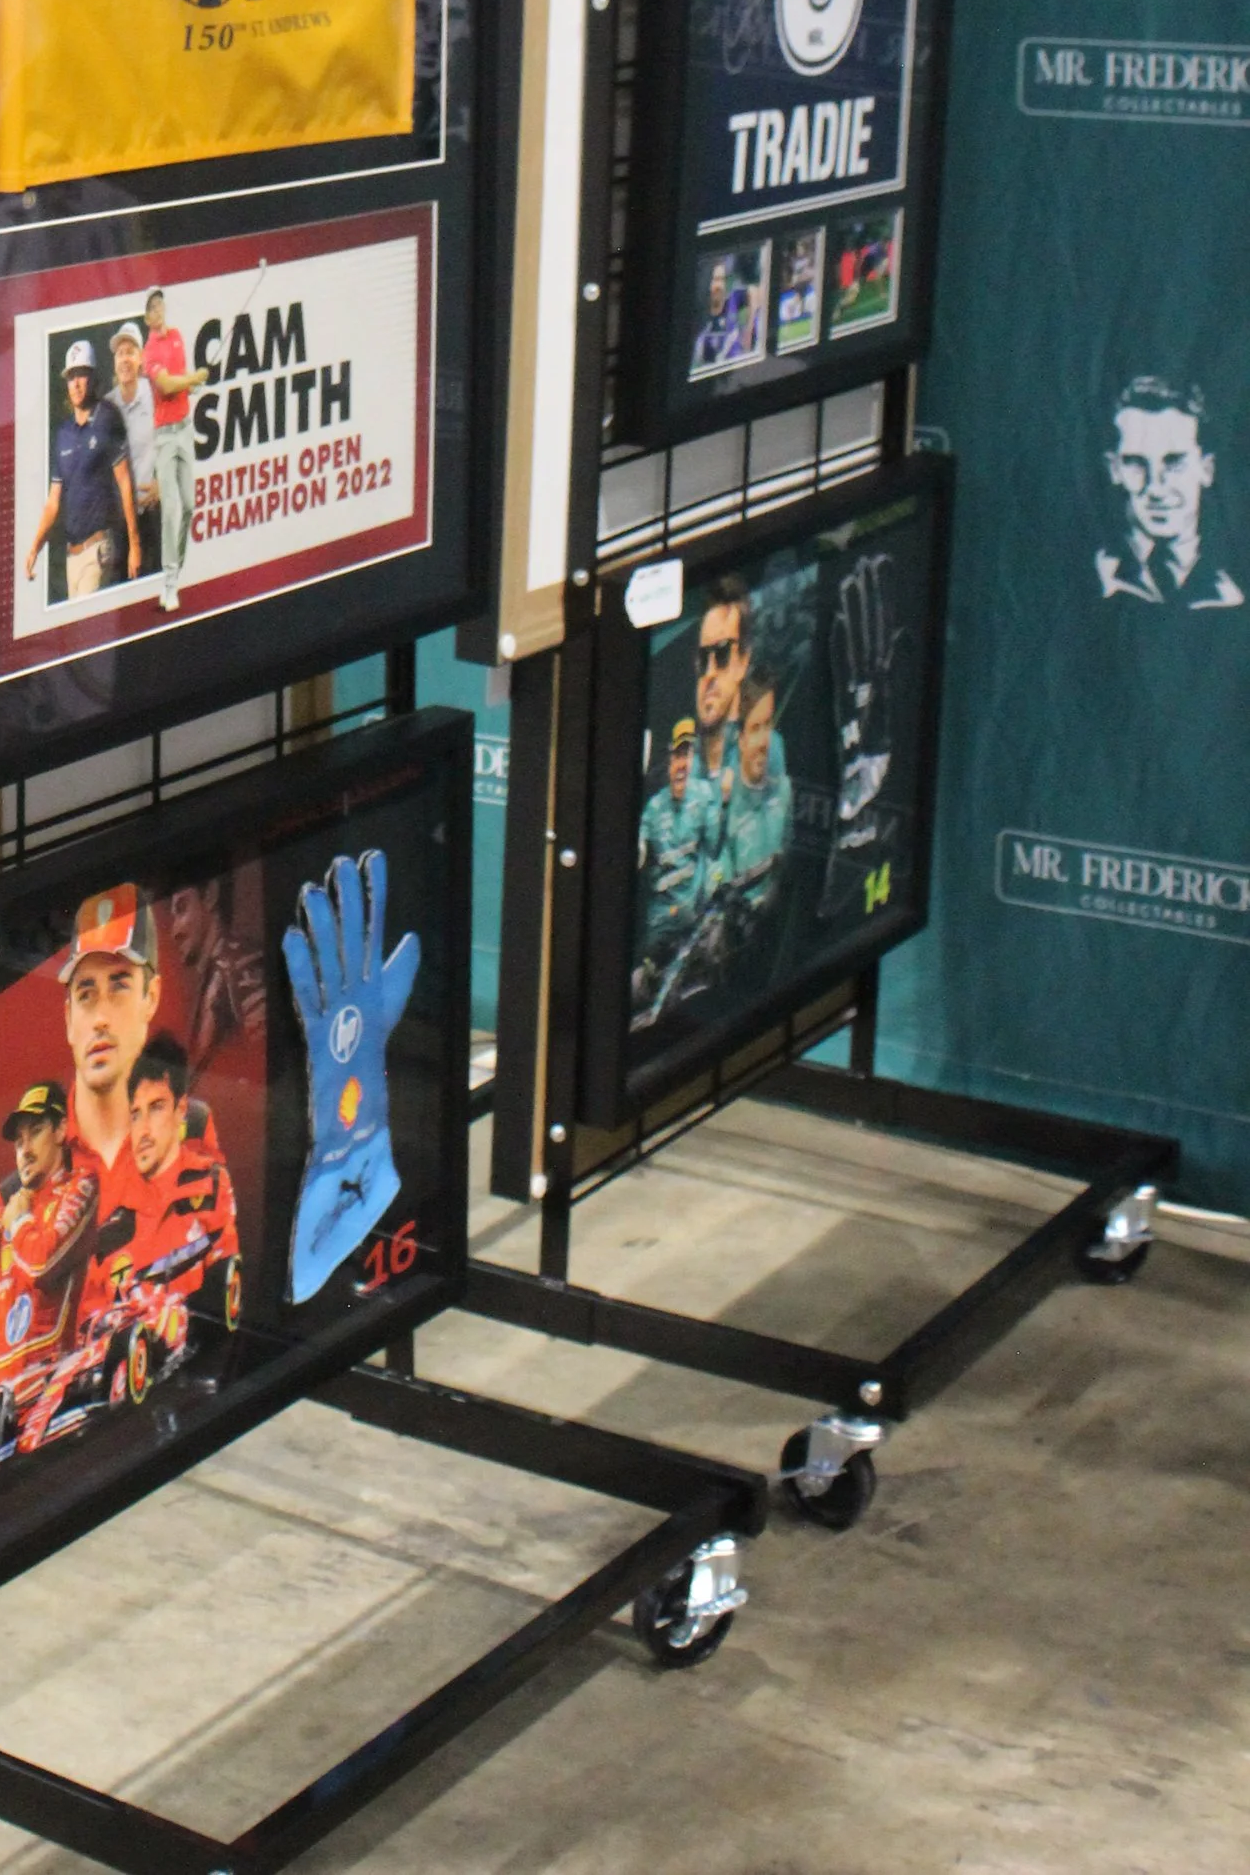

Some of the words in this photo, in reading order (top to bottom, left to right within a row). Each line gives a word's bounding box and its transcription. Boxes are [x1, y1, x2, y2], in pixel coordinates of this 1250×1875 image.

[727, 95, 876, 195] TRADIE
[193, 300, 307, 388] CAM
[192, 359, 352, 462] SMITH
[190, 477, 328, 544] CHAMPION
[335, 457, 394, 502] 2022
[193, 453, 289, 510] BRITISH
[297, 433, 362, 479] OPEN
[361, 1220, 418, 1294] 16
